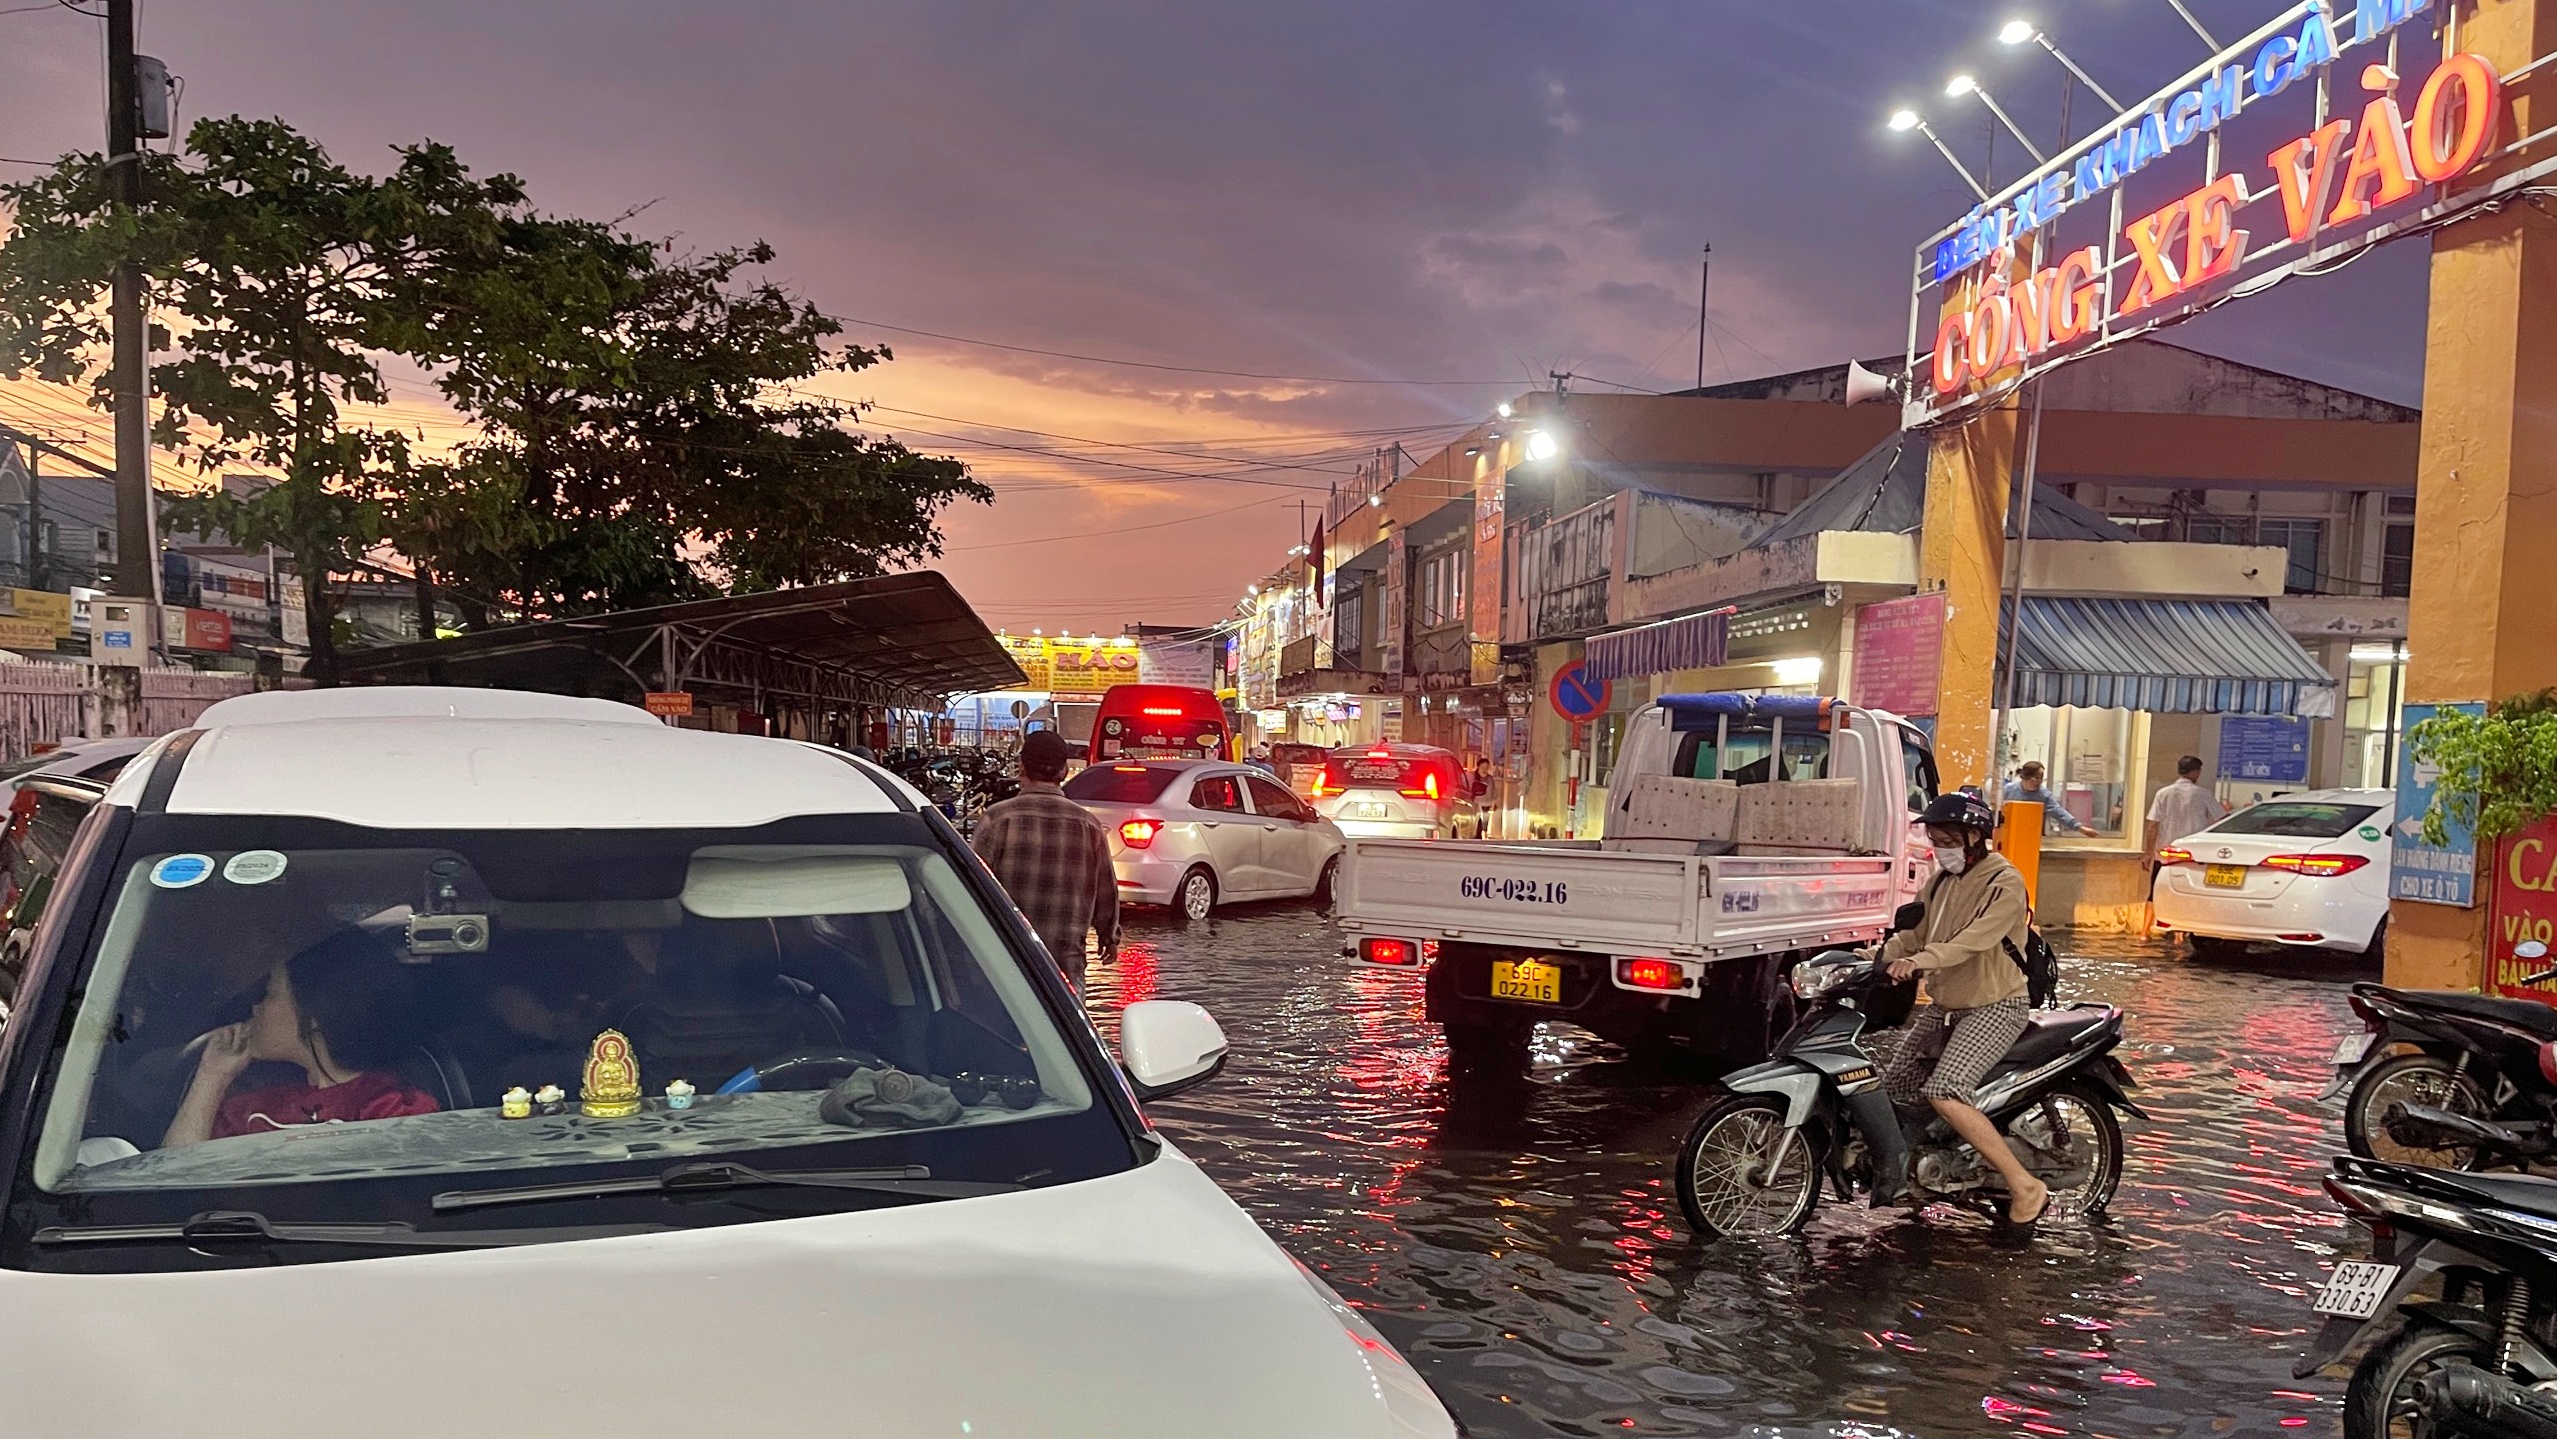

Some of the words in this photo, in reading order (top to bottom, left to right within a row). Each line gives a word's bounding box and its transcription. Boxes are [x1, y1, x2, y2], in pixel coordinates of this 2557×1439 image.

[1935, 203, 2009, 282] BẾN
[2011, 171, 2069, 240] XE
[2074, 65, 2244, 204] KHÁCH
[2253, 0, 2340, 96] CÀ
[1933, 246, 2105, 393] CỔNG
[2120, 173, 2249, 315] XE
[2268, 53, 2500, 242] VÀO
[1461, 876, 1567, 904] 69C-022.16
[2400, 875, 2419, 897] CHO
[2421, 877, 2433, 898] XE
[2436, 875, 2443, 899] Ô
[2446, 876, 2459, 901] TÔ
[2504, 909, 2553, 946] VÀO
[1512, 966, 1542, 981] 69C
[1837, 1068, 1872, 1083] YAMAHA
[2336, 1264, 2384, 1288] 69-B1
[2316, 1288, 2375, 1314] 330.63
